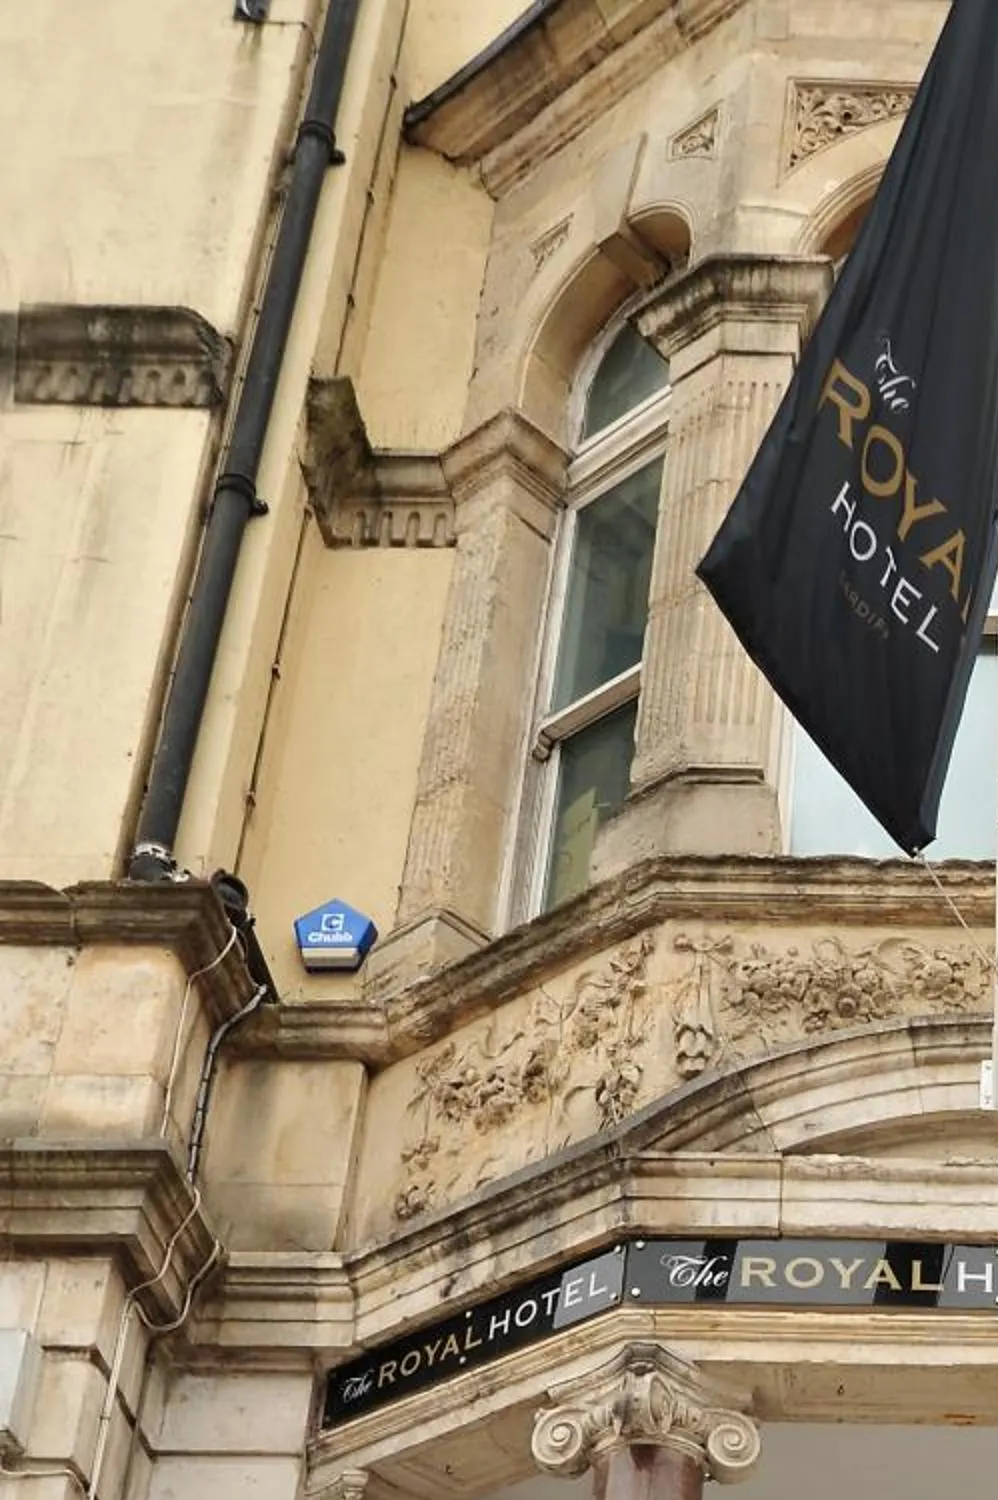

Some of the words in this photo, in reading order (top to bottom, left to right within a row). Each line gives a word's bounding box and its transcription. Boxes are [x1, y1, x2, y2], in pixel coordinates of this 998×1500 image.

[831, 481, 940, 652] HOTEL
[377, 1321, 483, 1388] ROYAL
[488, 1271, 607, 1340] HOTEL
[659, 1254, 729, 1288] The
[740, 1256, 944, 1292] ROYAL
